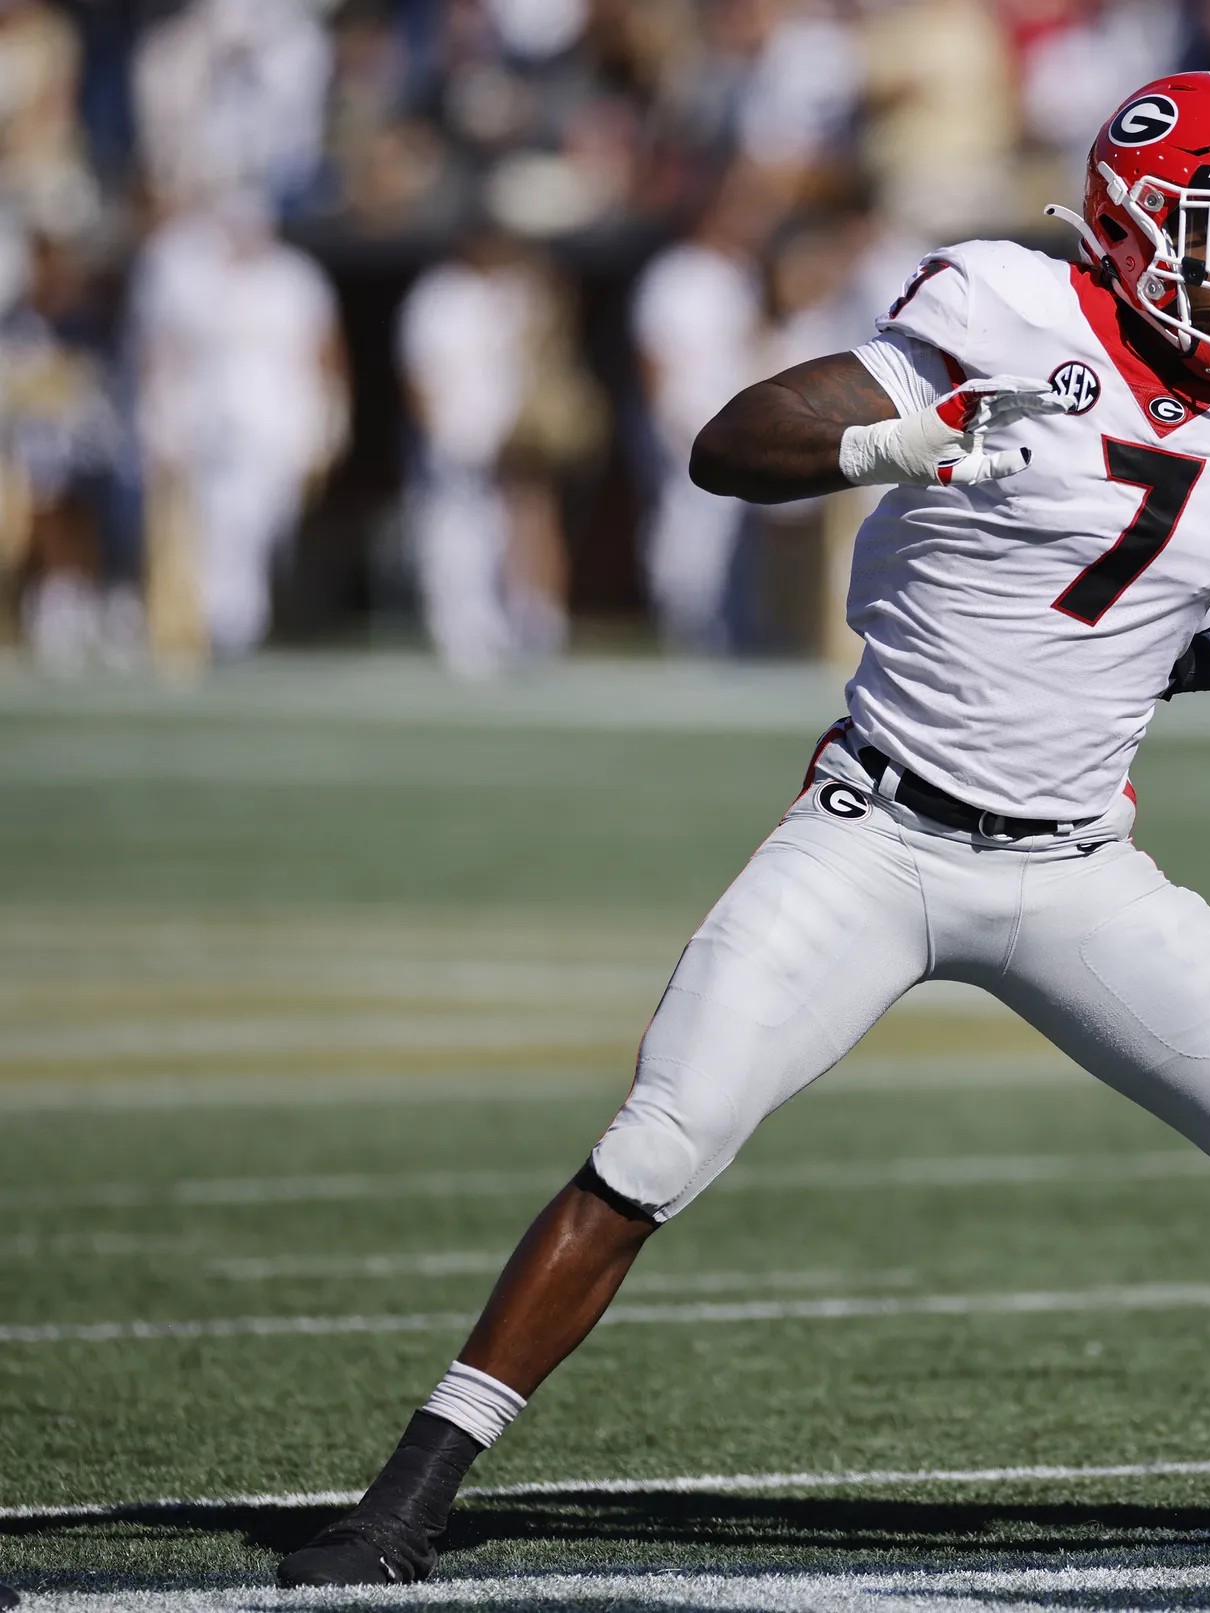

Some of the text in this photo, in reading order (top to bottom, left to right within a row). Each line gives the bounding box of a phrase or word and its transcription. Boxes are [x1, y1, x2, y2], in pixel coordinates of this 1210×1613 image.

[1109, 95, 1177, 145] G
[1054, 364, 1096, 411] SEC
[1149, 398, 1184, 422] G
[1050, 433, 1207, 627] 7
[818, 783, 868, 819] G
